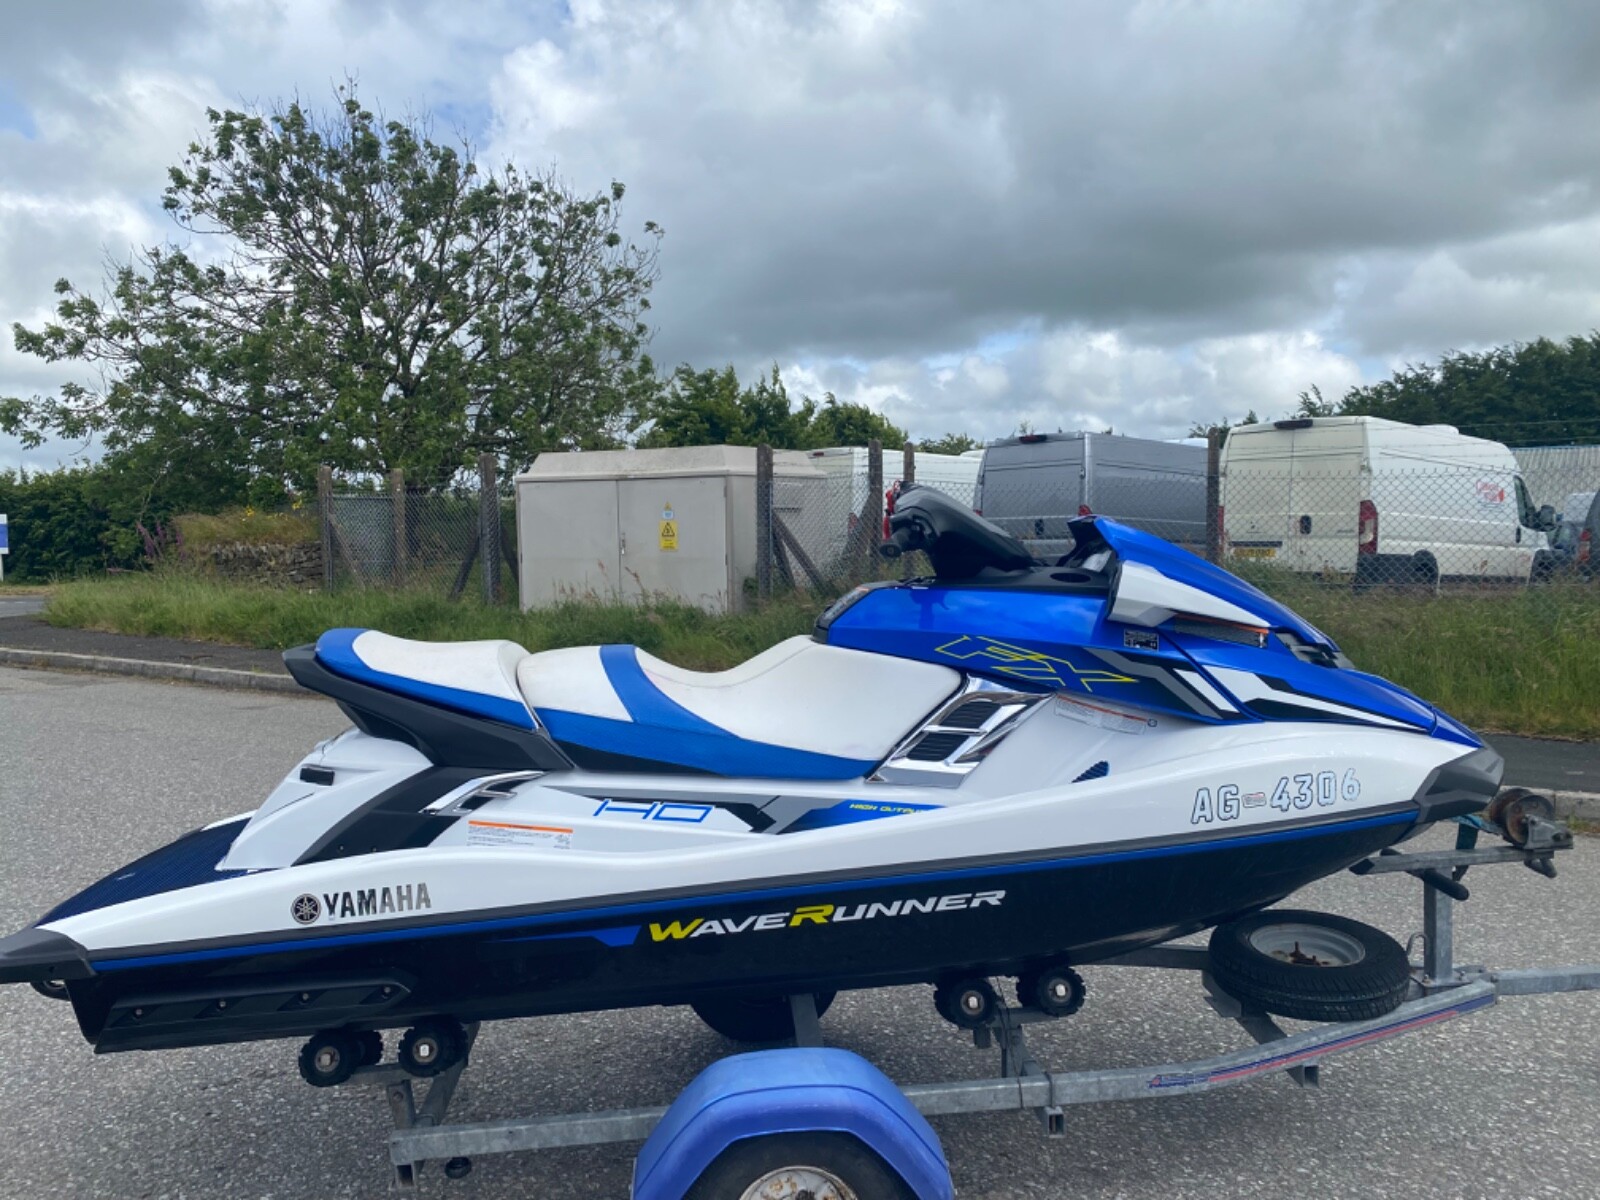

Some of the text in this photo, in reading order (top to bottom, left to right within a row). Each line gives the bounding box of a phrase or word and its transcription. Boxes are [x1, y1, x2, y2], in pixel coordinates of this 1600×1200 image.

[1190, 767, 1361, 824] AG 4306
[322, 882, 432, 919] YAMAHA
[649, 889, 1006, 942] WAVERUNNER
